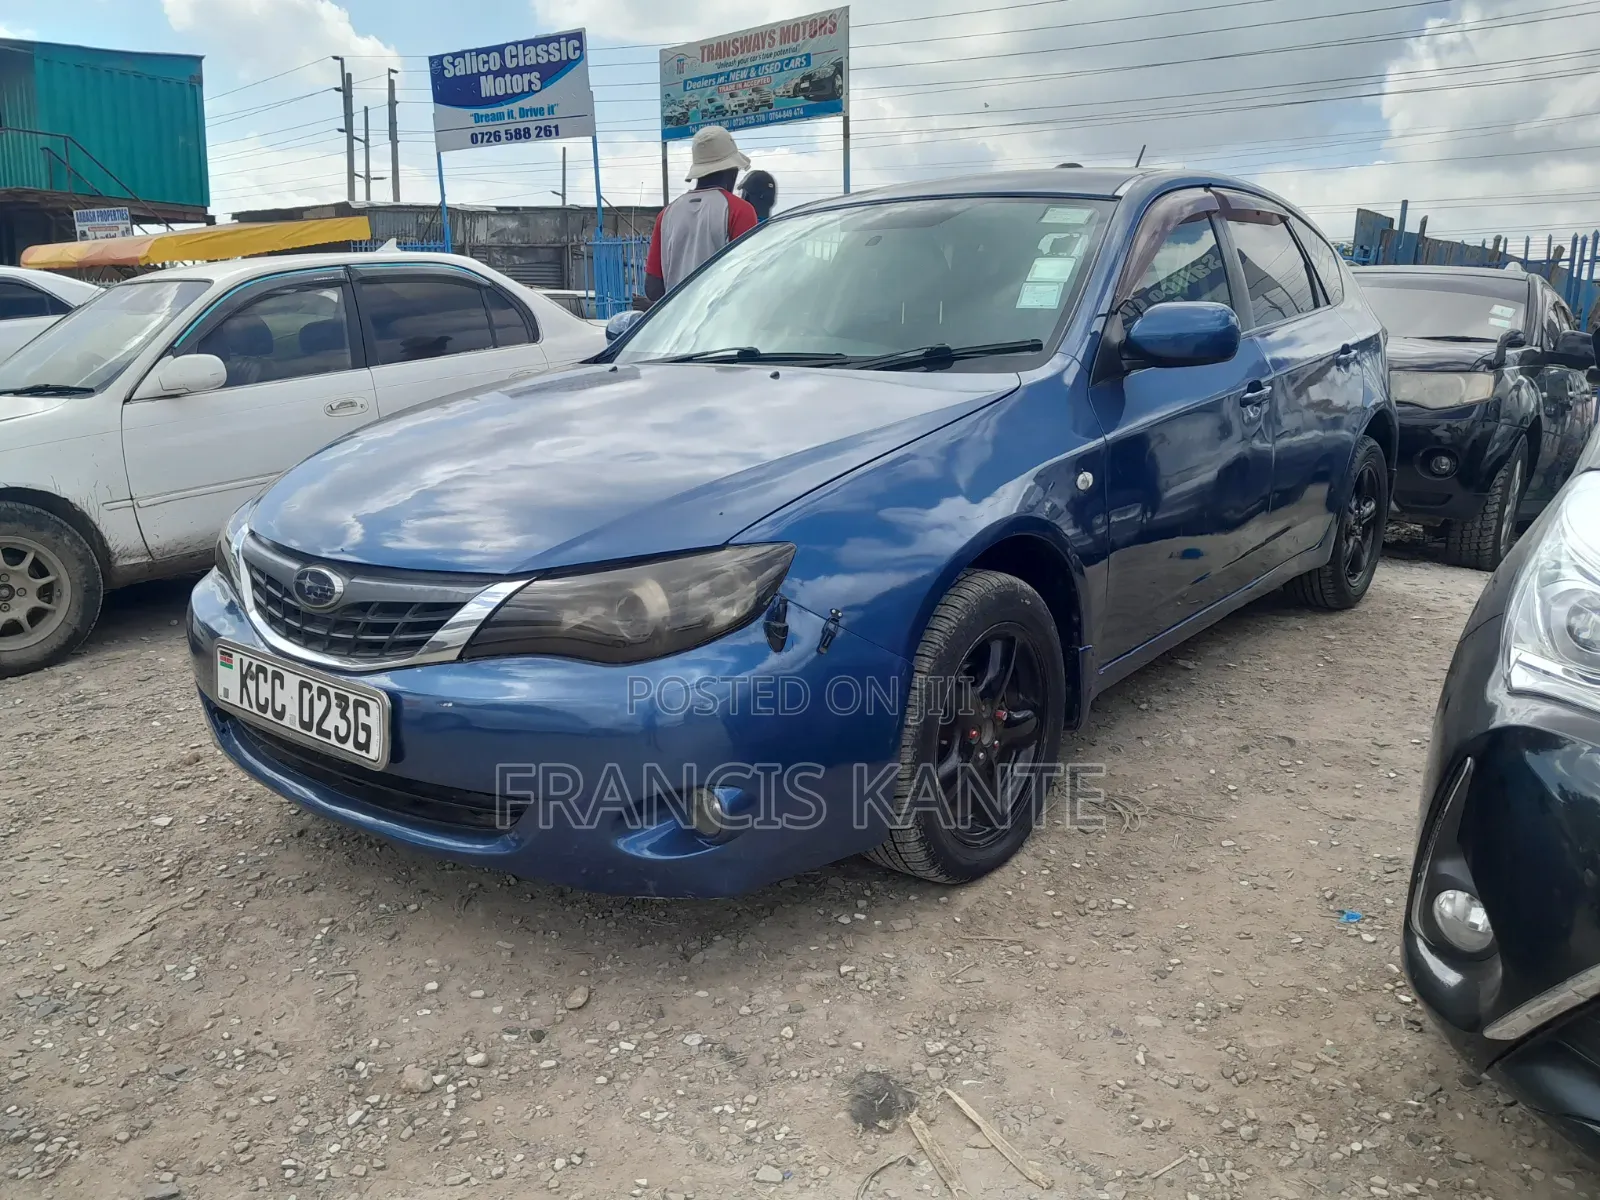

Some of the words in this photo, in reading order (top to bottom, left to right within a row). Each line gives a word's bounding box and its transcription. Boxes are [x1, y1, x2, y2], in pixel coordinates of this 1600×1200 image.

[700, 29, 776, 63] TRANSWAYS
[779, 13, 838, 46] MOTORS
[443, 51, 501, 78] Salico
[504, 37, 581, 69] Classic
[480, 71, 542, 98] Motors
[686, 75, 716, 91] Dealers
[716, 74, 728, 86] in:
[729, 68, 749, 82] NEW
[750, 67, 757, 77] &
[758, 61, 780, 76] USED
[783, 56, 807, 71] CARS
[719, 85, 736, 94] TRADE
[743, 78, 771, 89] ACCEPTED
[518, 105, 545, 119] Drive
[470, 130, 502, 145] 0726
[505, 126, 532, 141] 588
[534, 124, 560, 139] 261
[97, 209, 128, 222] PROPERTIES
[239, 657, 286, 722] KCC
[298, 680, 372, 754] 023G
